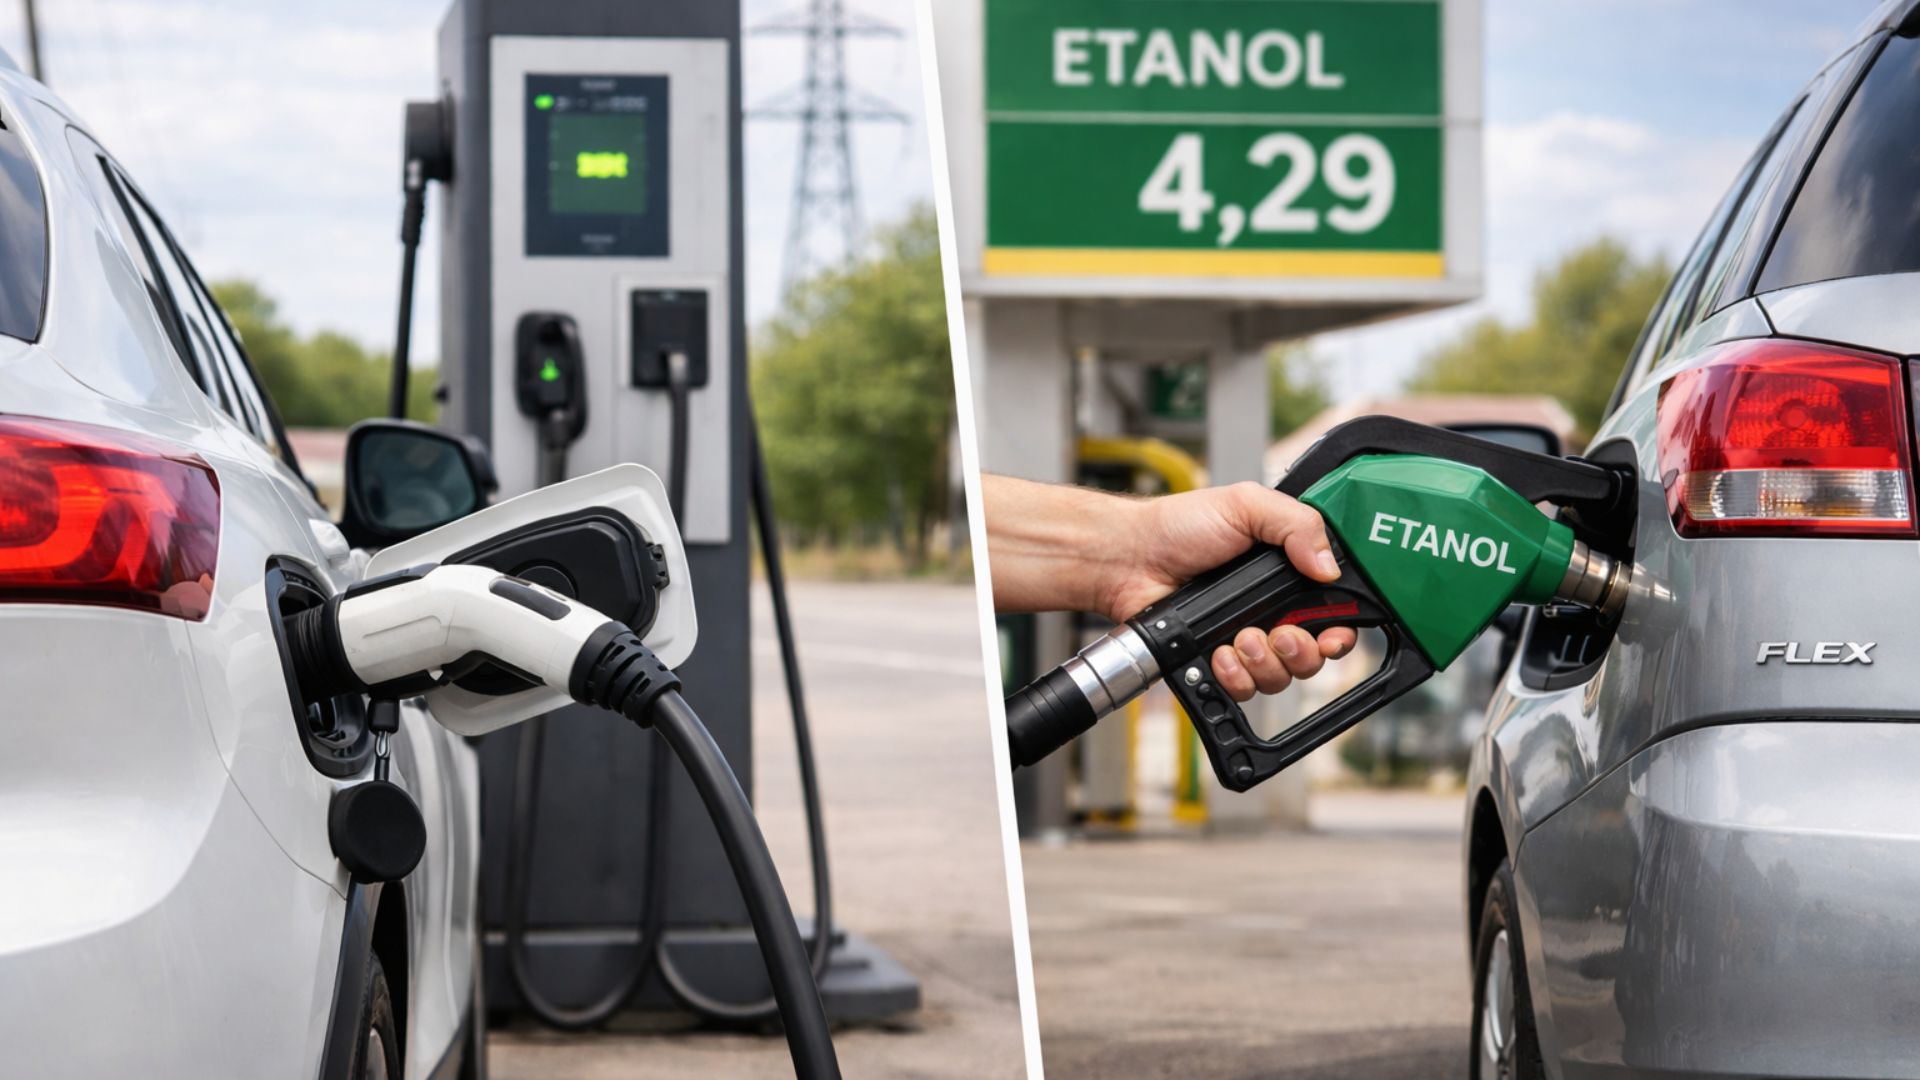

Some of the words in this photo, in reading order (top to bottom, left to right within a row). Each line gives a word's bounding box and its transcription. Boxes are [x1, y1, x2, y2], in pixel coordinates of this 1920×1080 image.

[1053, 28, 1345, 88] ETANOL
[1137, 132, 1396, 247] 4,29
[1368, 511, 1517, 574] ETANOL
[1755, 641, 1877, 665] FLEX
